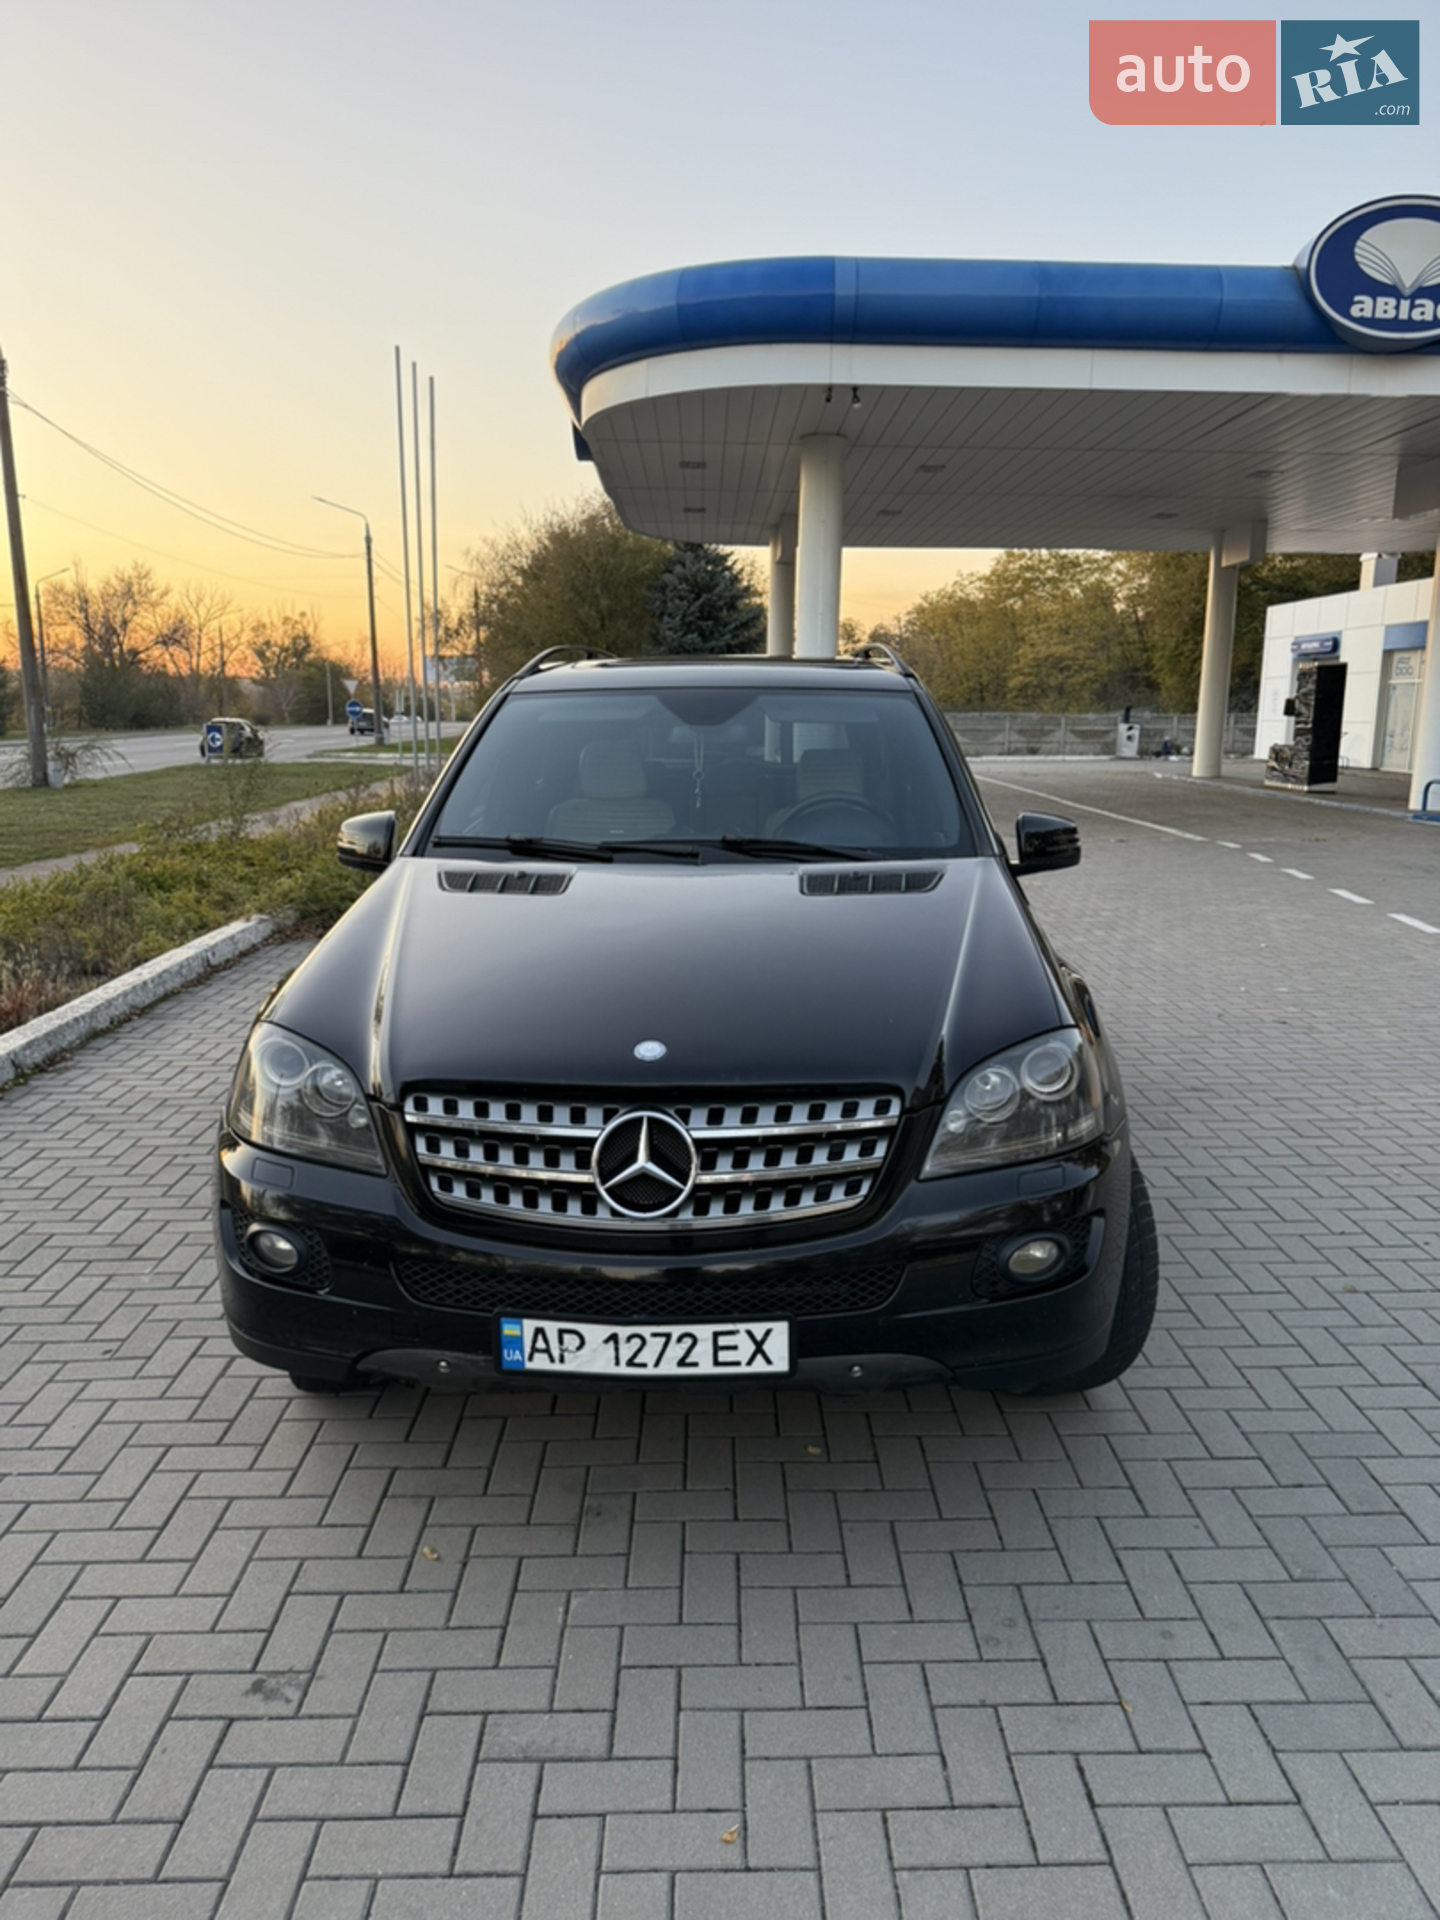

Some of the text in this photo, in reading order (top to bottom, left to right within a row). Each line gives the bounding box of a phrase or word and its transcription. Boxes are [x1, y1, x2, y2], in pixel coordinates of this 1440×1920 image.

[503, 1349, 522, 1362] UA
[527, 1326, 774, 1368] AP 1272 EX
